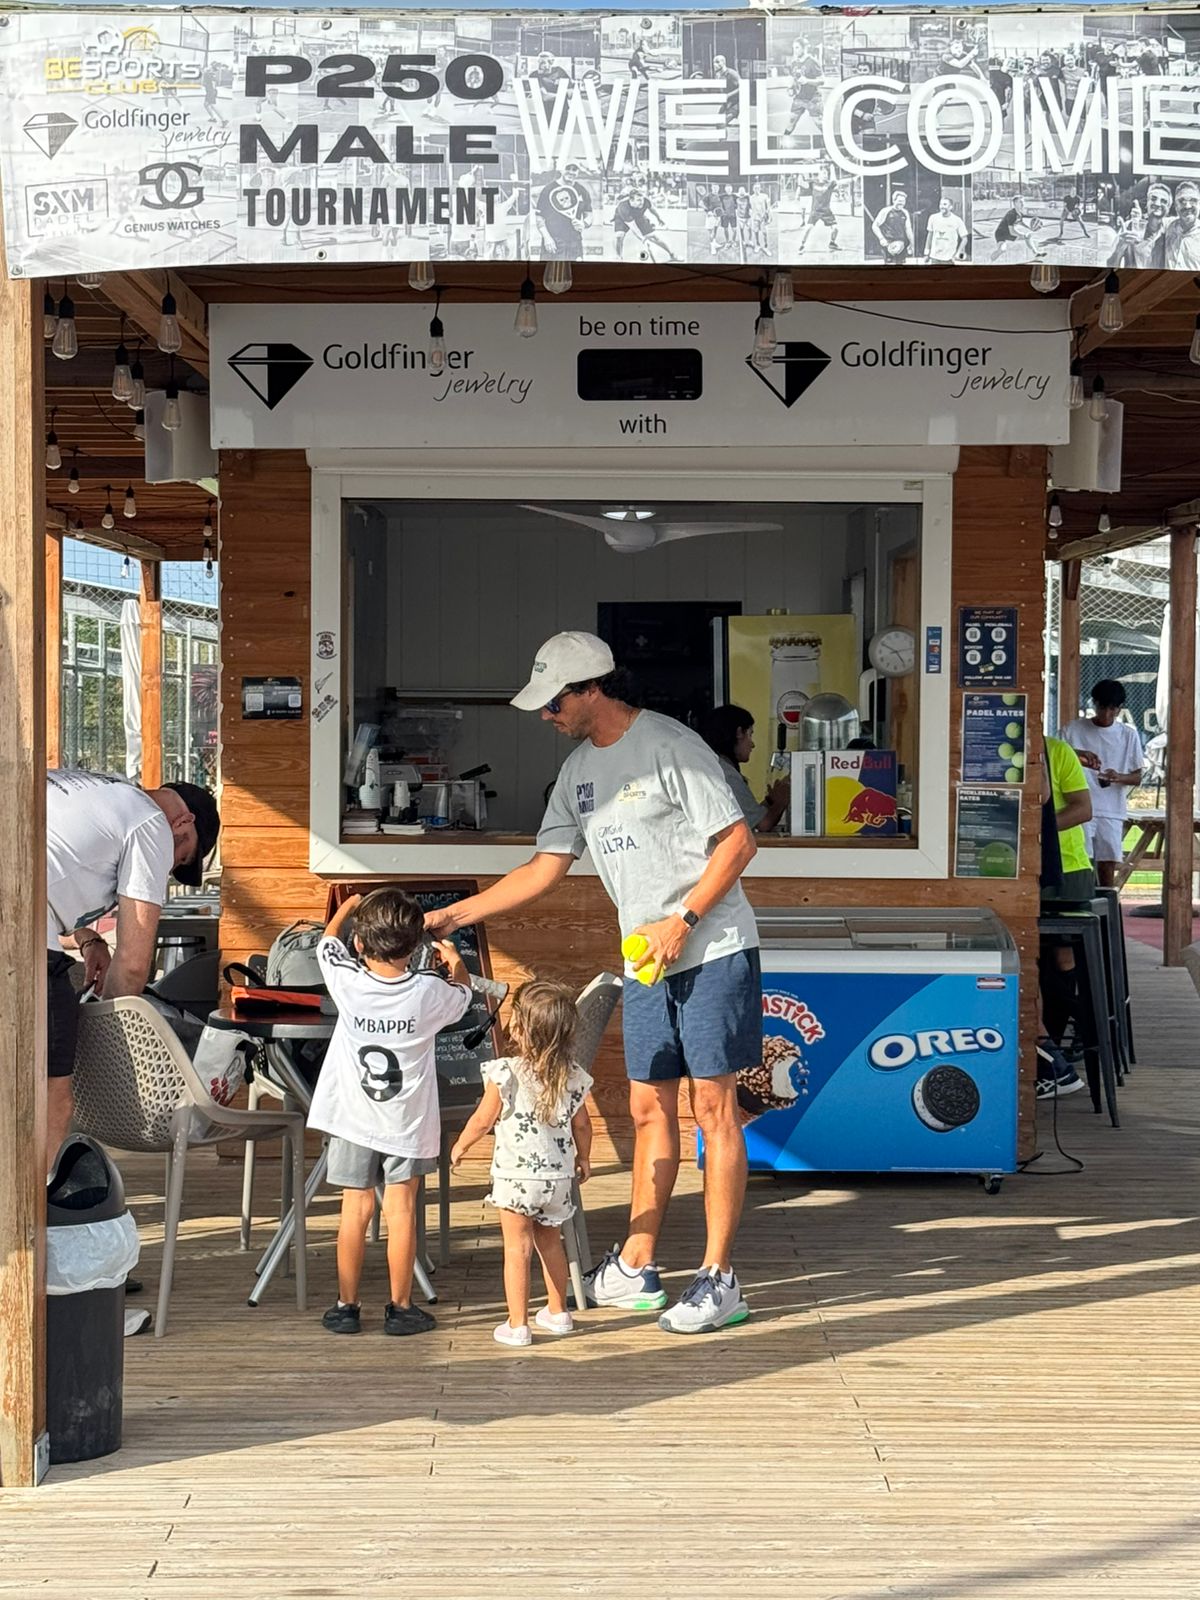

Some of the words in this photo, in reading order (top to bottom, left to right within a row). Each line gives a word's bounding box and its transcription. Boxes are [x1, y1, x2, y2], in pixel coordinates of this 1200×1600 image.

[85, 80, 159, 95] CLUB
[245, 54, 504, 100] P250
[84, 109, 191, 131] Goldfinger
[513, 73, 1200, 177] WELCOME
[163, 127, 232, 148] jewelry
[240, 124, 500, 164] MALE
[33, 188, 95, 216] SXM
[243, 187, 499, 227] TOURNAMENT
[124, 222, 165, 233] GENIUS
[167, 220, 221, 231] WATCHES
[579, 316, 606, 335] be
[613, 320, 642, 335] on
[649, 316, 700, 335] time
[841, 340, 992, 374] Goldfinger
[433, 371, 533, 404] jewelry
[950, 367, 1051, 400] jewelry
[619, 413, 667, 433] with
[830, 756, 860, 769] Red
[863, 756, 892, 769] Bull
[354, 1016, 416, 1034] MBAPPÉ
[870, 1028, 1004, 1068] OREO
